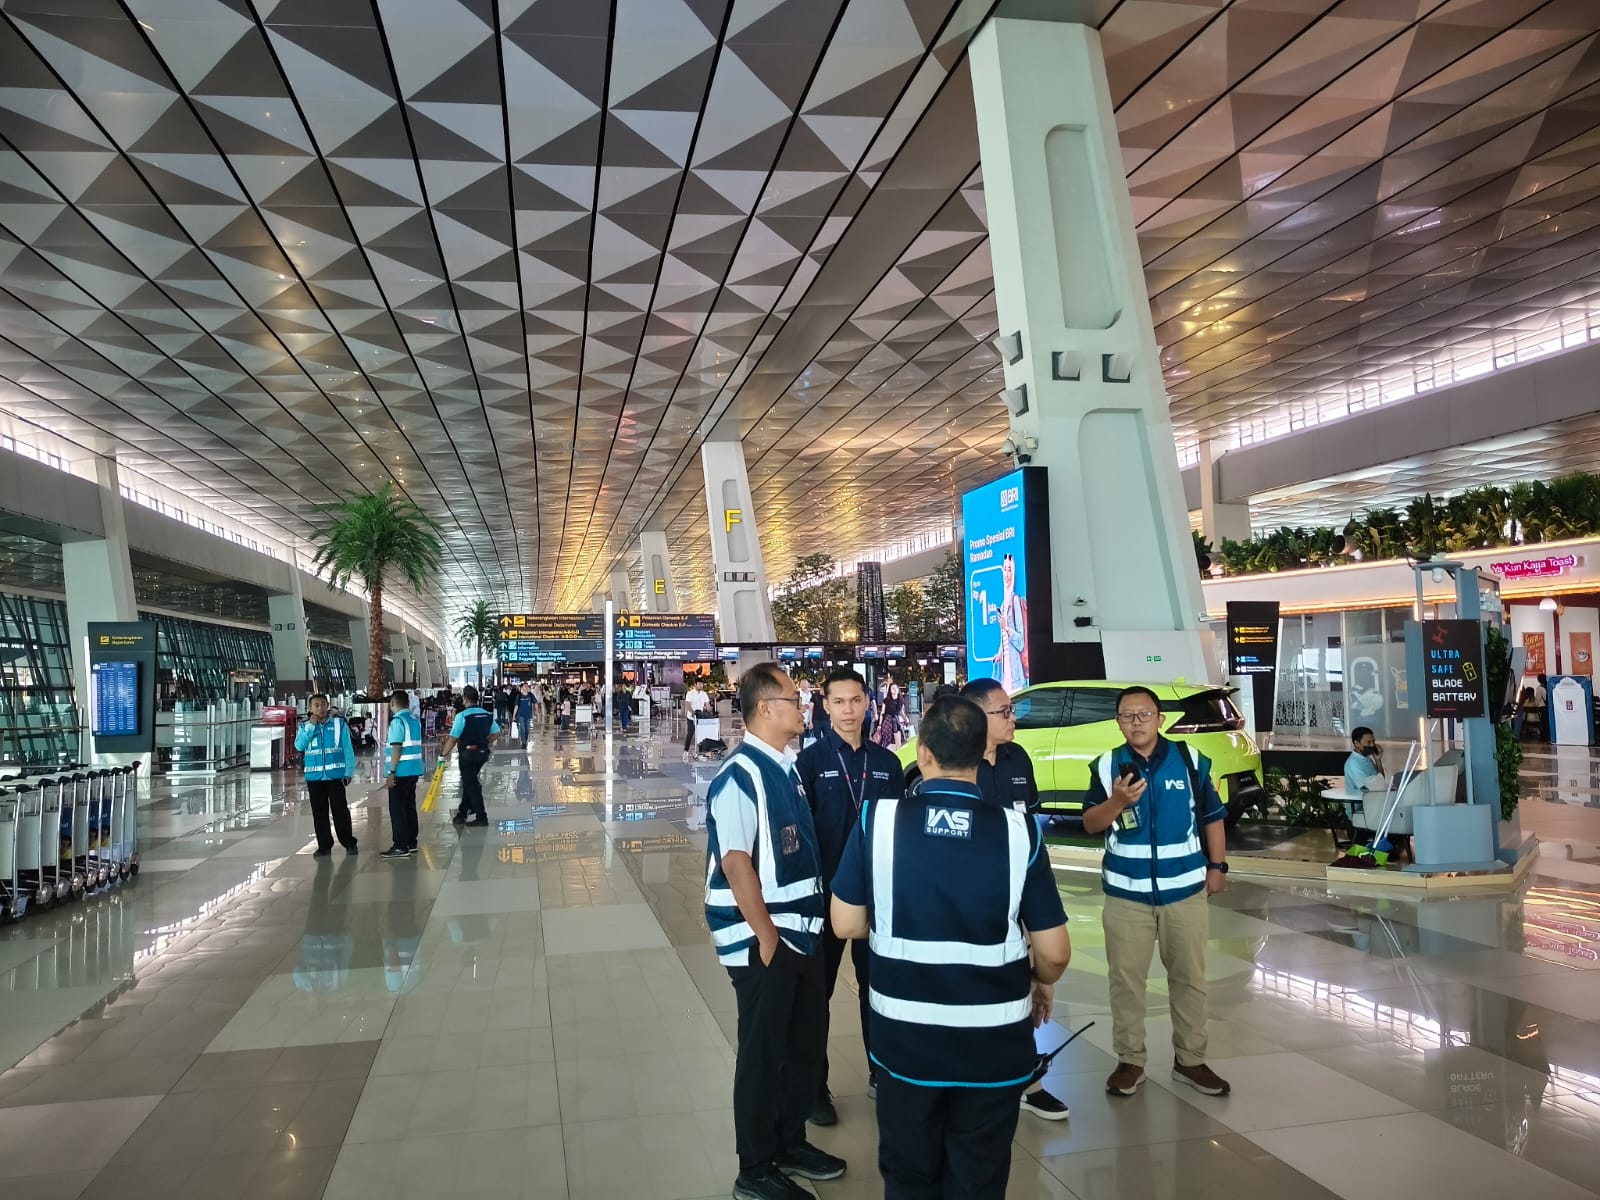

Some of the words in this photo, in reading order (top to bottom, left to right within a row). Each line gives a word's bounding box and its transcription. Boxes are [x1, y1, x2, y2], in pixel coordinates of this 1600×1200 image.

[1007, 487, 1019, 503] BRI
[725, 509, 742, 533] F
[969, 536, 987, 551] Promo
[986, 530, 1005, 548] Spesial
[1005, 526, 1015, 540] BRI
[1492, 565, 1503, 573] Ya
[1504, 563, 1522, 572] Kun
[1523, 561, 1546, 572] Kaya
[1547, 557, 1573, 567] Toast
[655, 579, 666, 594] E
[979, 590, 988, 626] 1
[1430, 649, 1460, 659] ULTRA
[1431, 664, 1454, 674] SAFE
[1432, 679, 1463, 688] BLADE
[1432, 692, 1477, 702] BATTERY
[1164, 779, 1185, 790] IAS
[927, 807, 970, 831] IAS
[926, 826, 969, 838] SUPPORT
